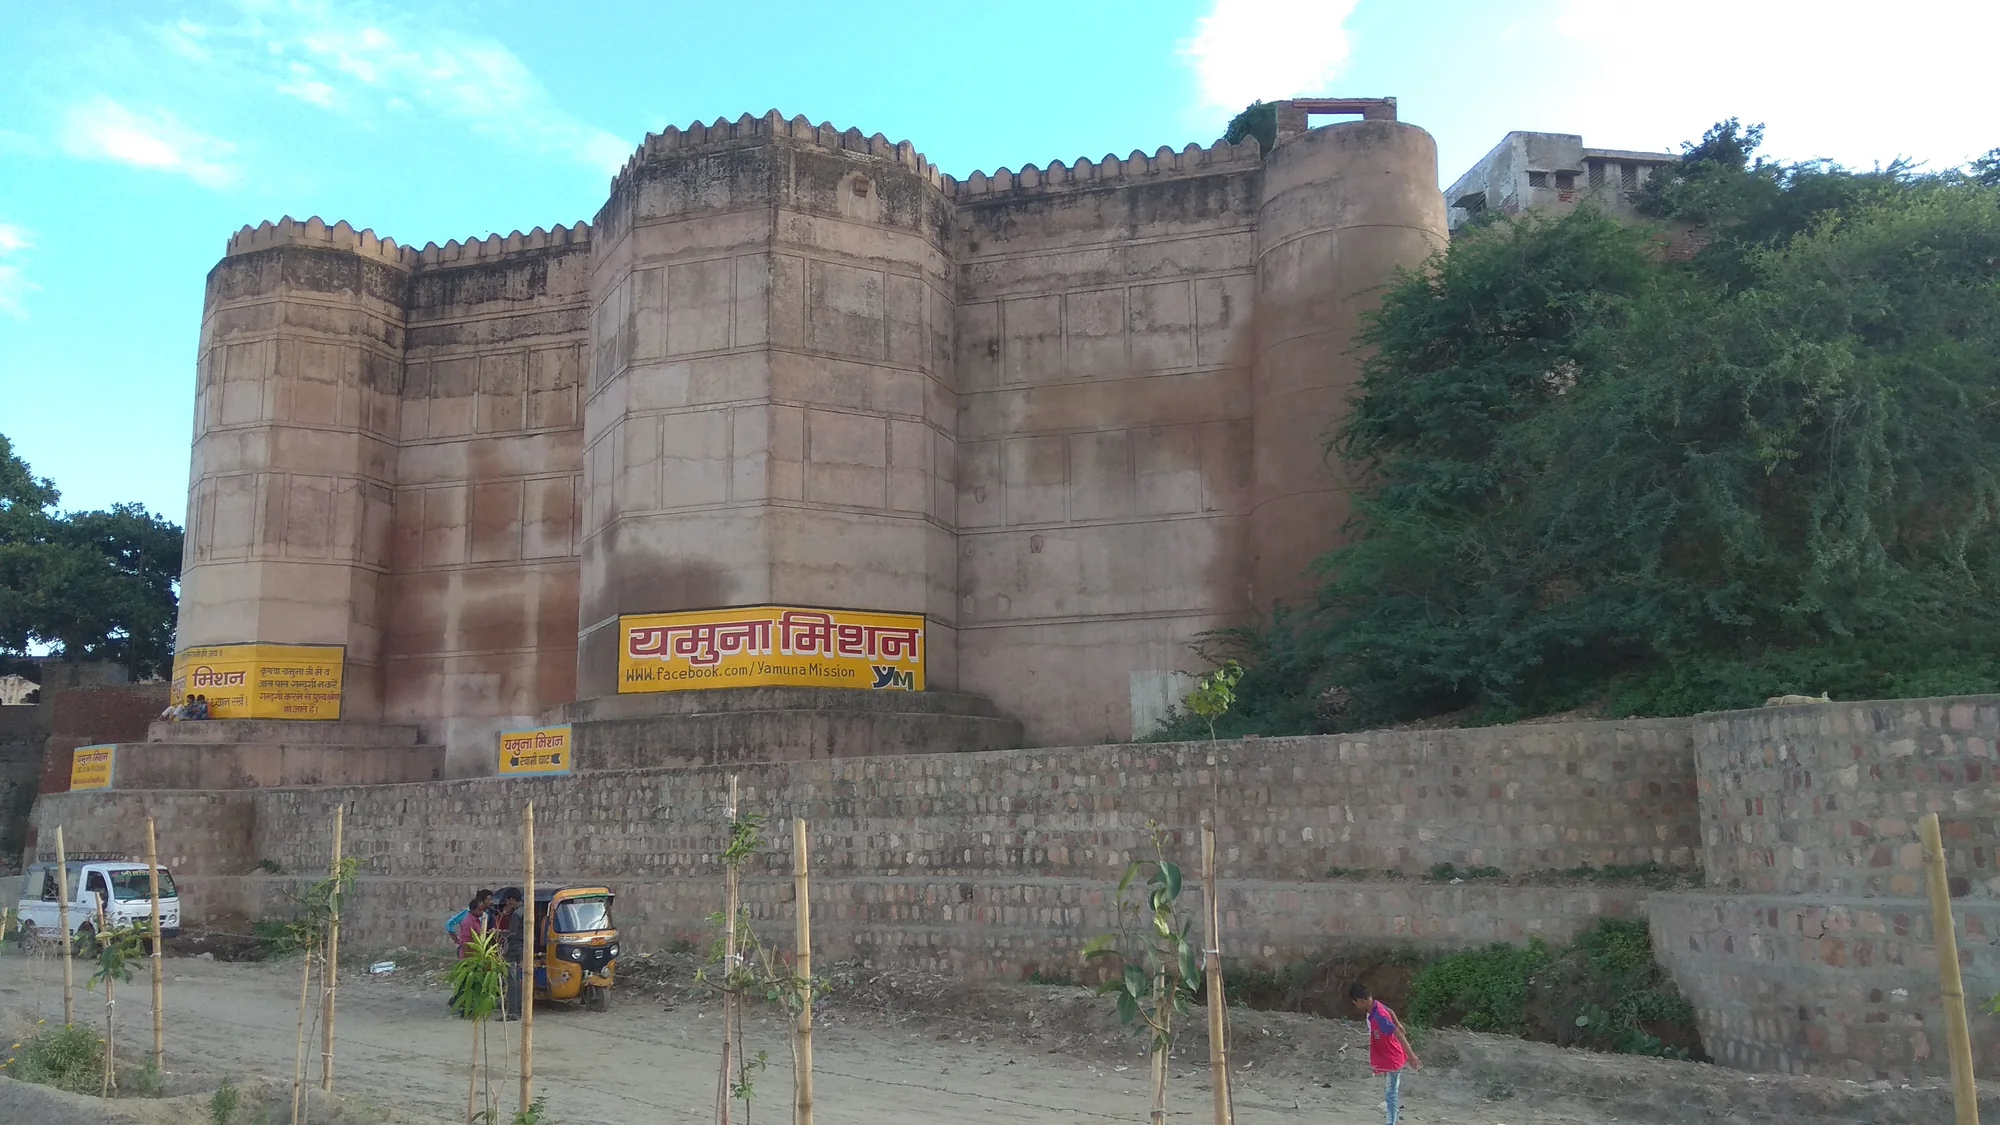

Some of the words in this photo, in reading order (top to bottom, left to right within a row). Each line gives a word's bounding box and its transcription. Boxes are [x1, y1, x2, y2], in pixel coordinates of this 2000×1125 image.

[629, 619, 774, 667] यमुना
[778, 611, 921, 661] मिशन
[192, 665, 247, 688] मिशन
[505, 738, 533, 756] यमुना
[535, 732, 564, 749] मिशन
